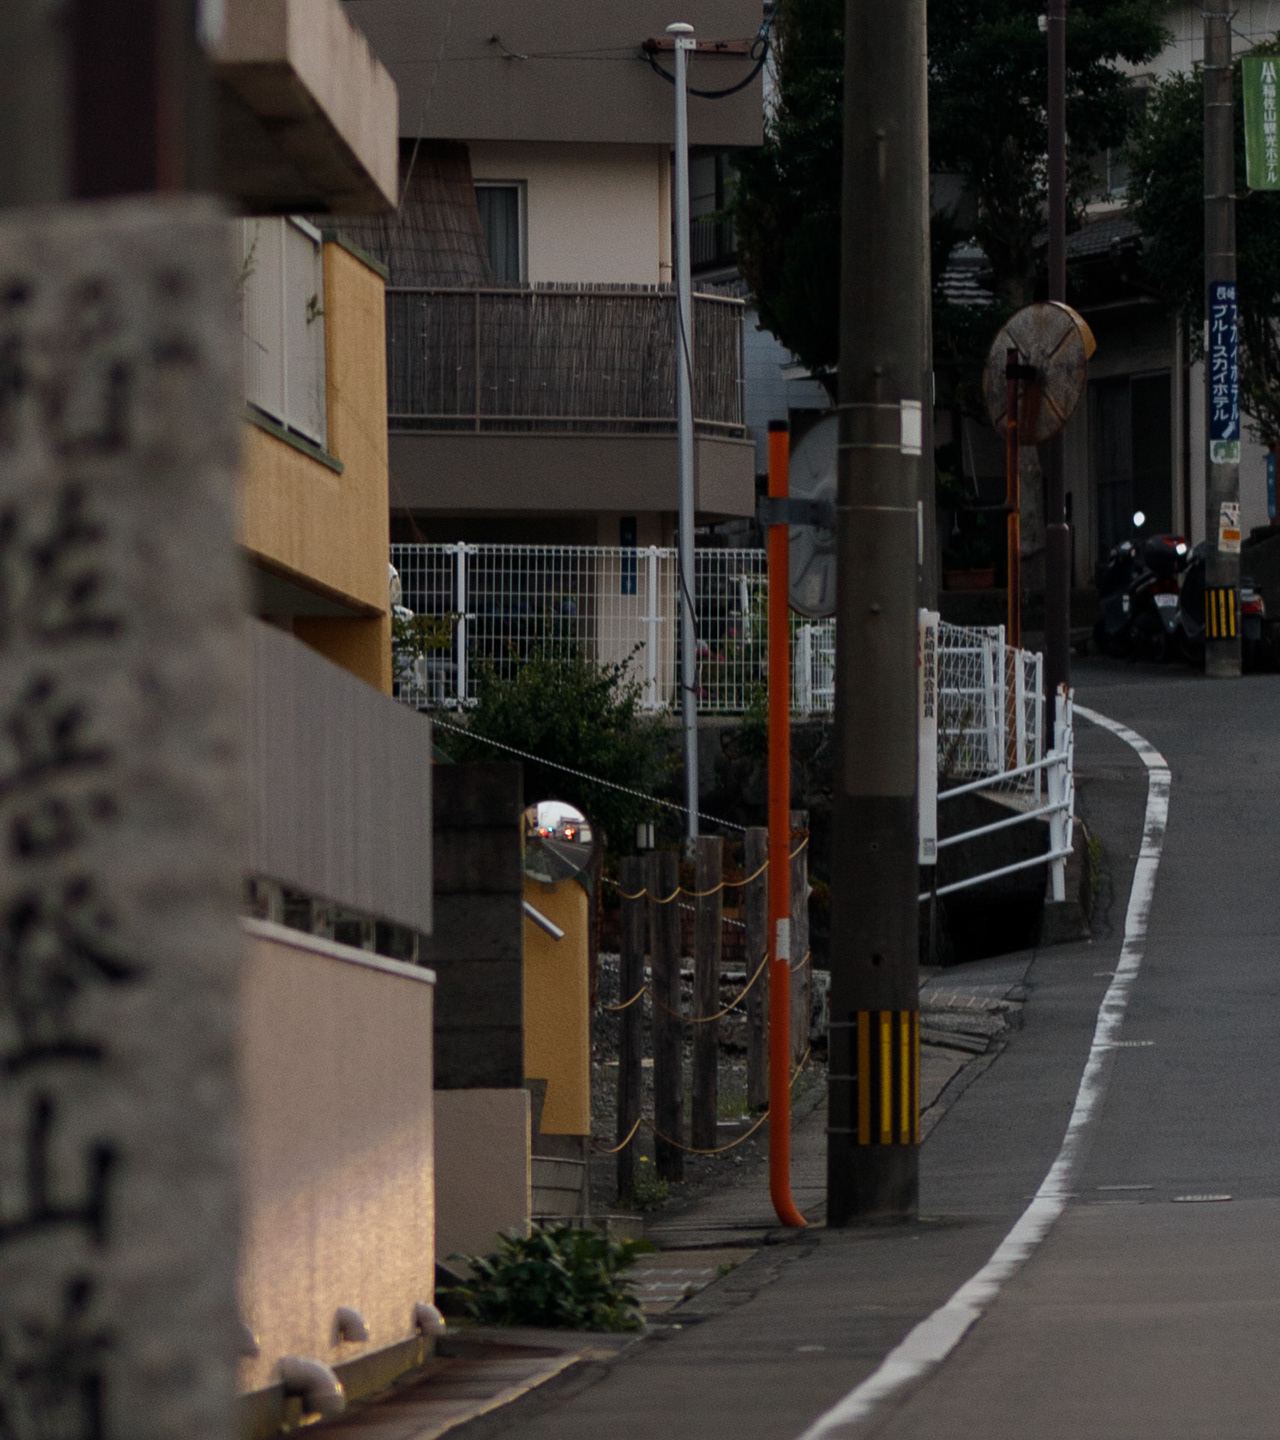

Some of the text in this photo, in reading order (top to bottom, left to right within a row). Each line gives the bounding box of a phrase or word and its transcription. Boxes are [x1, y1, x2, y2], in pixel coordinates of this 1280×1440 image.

[1262, 83, 1278, 183] 稲佐山観光ホテル
[1216, 287, 1236, 300] 長崎
[1212, 305, 1229, 422] ブルースカイホテル
[924, 626, 935, 718] 長崎県議会議員
